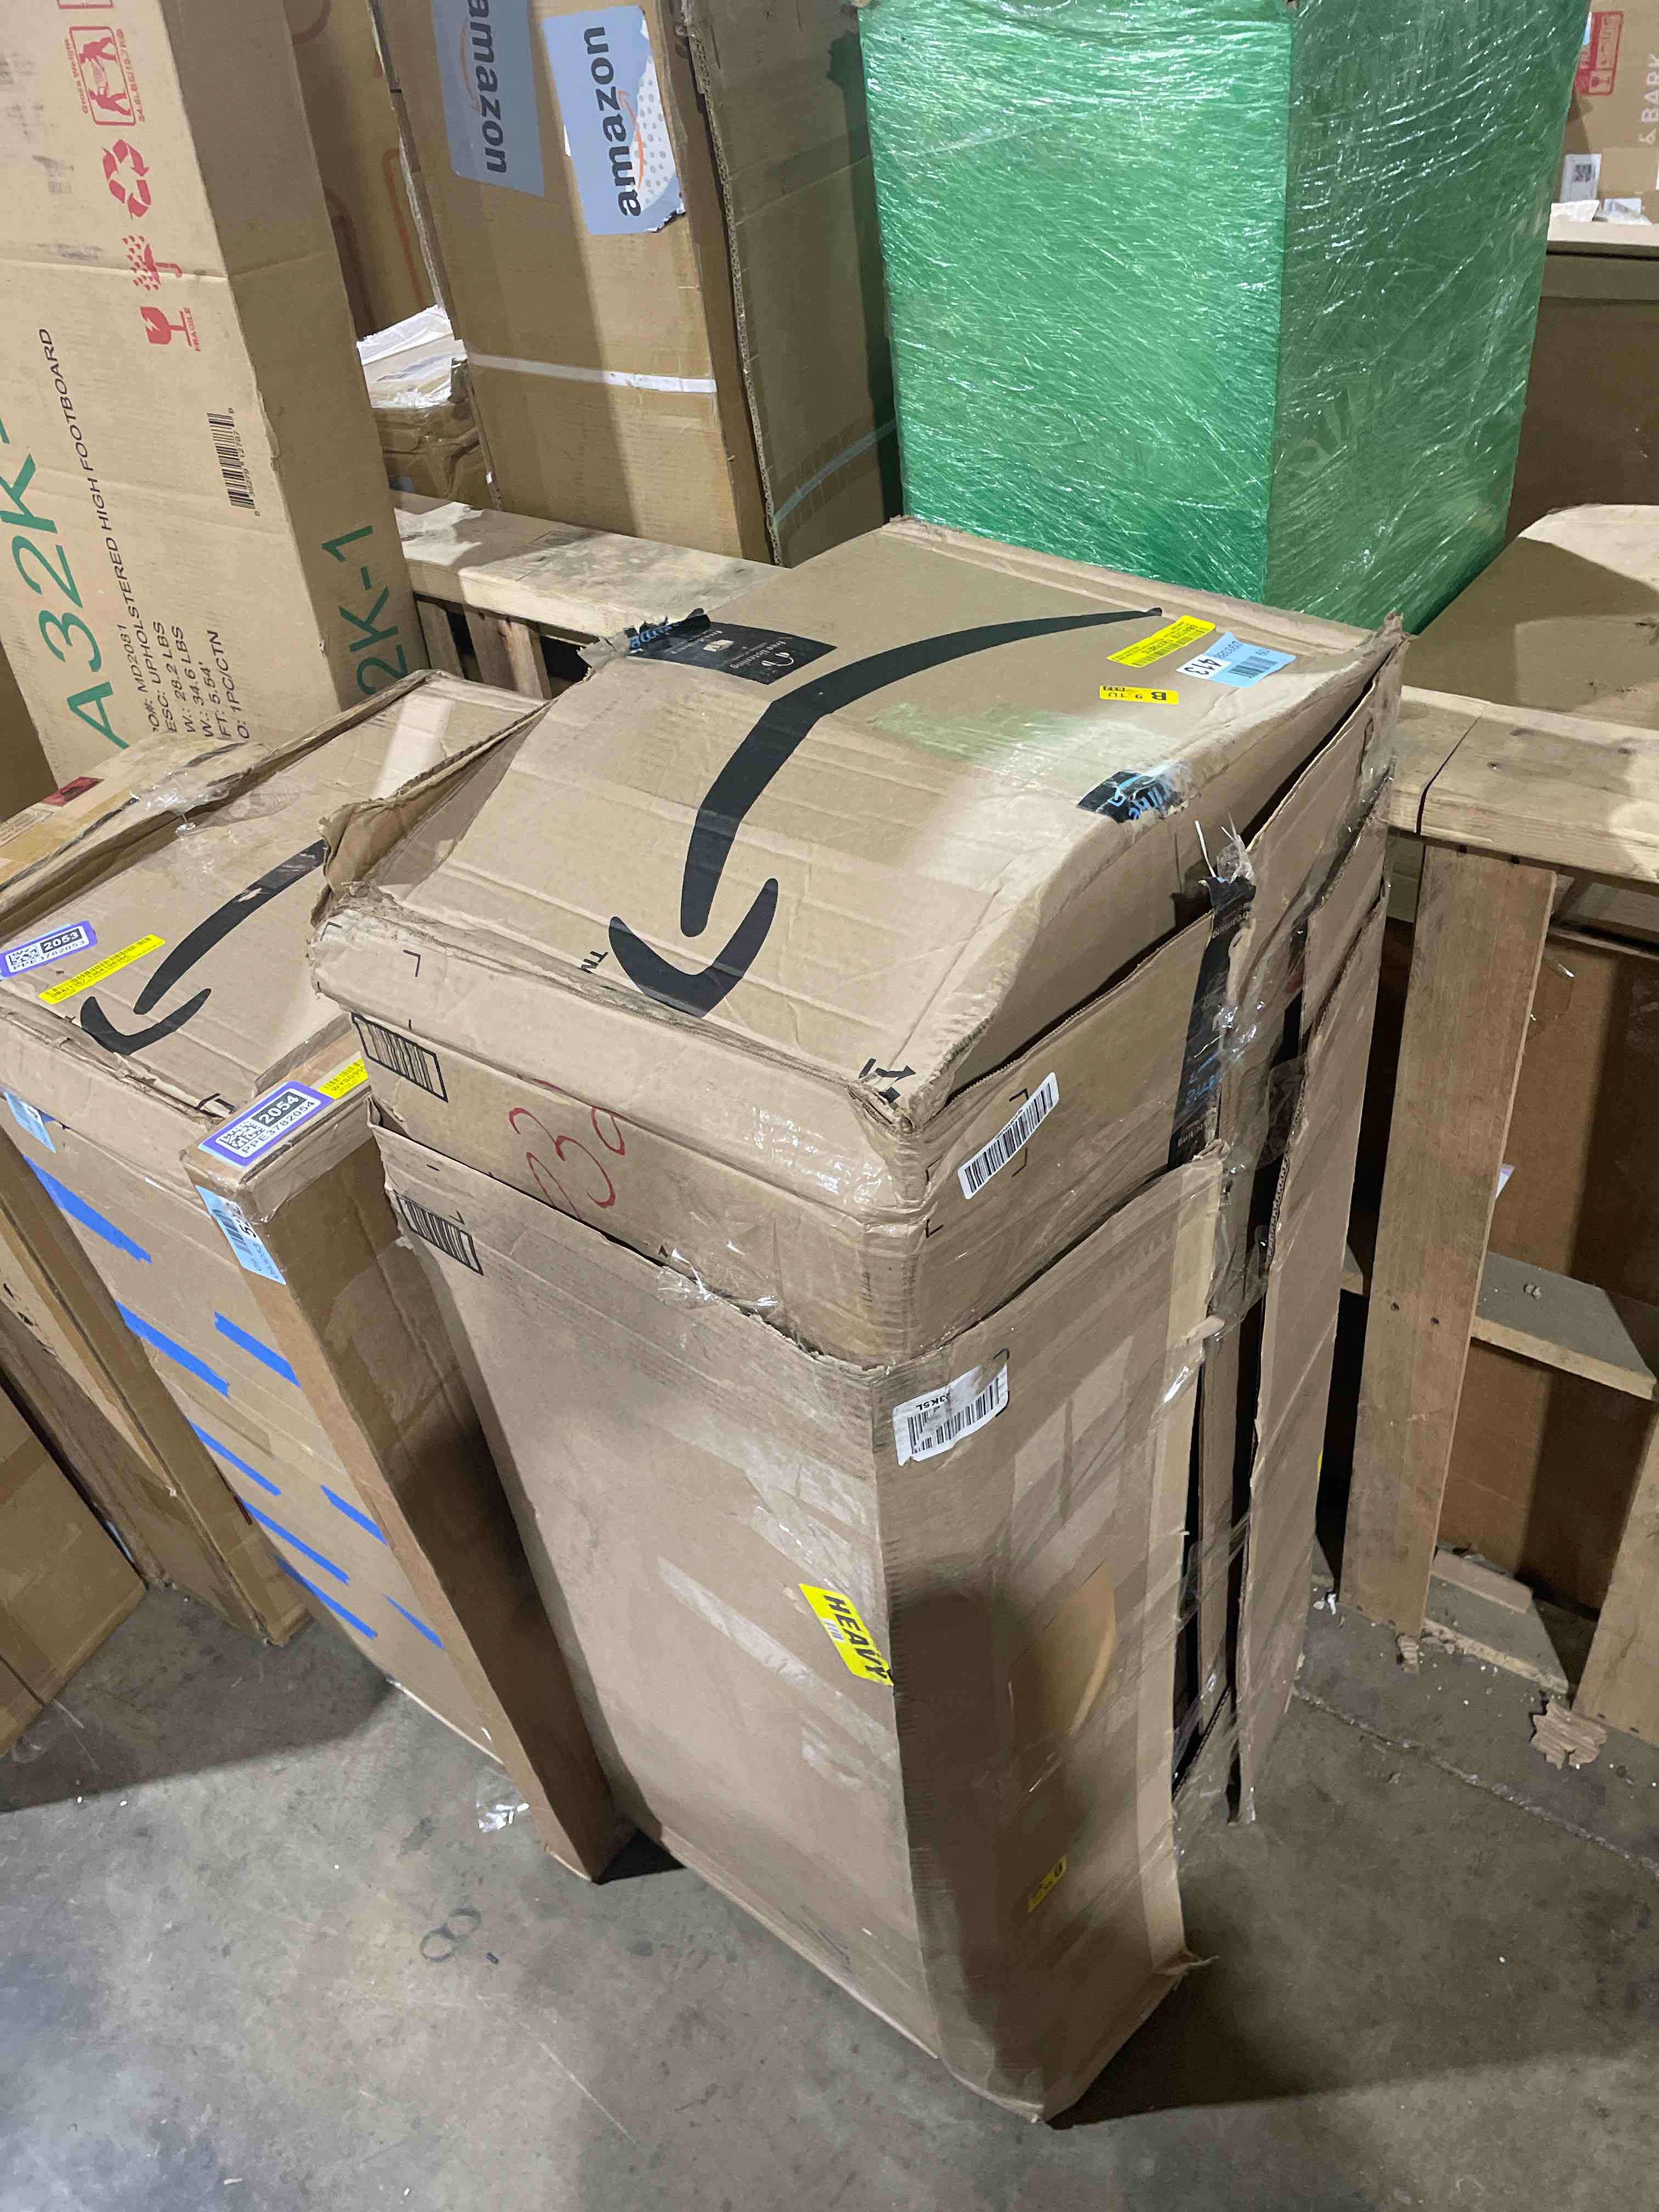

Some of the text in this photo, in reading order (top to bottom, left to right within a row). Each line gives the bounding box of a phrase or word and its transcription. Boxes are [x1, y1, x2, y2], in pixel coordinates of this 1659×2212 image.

[468, 0, 507, 173] amazon
[584, 27, 641, 216] amazon
[39, 329, 178, 733] ESC: UPHOLSTERED HIGH FOOTBOARD
[117, 624, 148, 693] MD2081
[153, 621, 173, 658] LBS
[172, 625, 191, 664] LBS
[166, 663, 186, 702] 28.2
[206, 630, 242, 713] 1PC/CTN
[1183, 658, 1222, 676] 413
[184, 668, 204, 706] 34.6
[1150, 691, 1167, 701] B
[43, 931, 80, 952] 2053
[241, 1100, 315, 1154] PPE3782054
[258, 1094, 300, 1125] 2054
[823, 1594, 895, 1686] HEAVY
